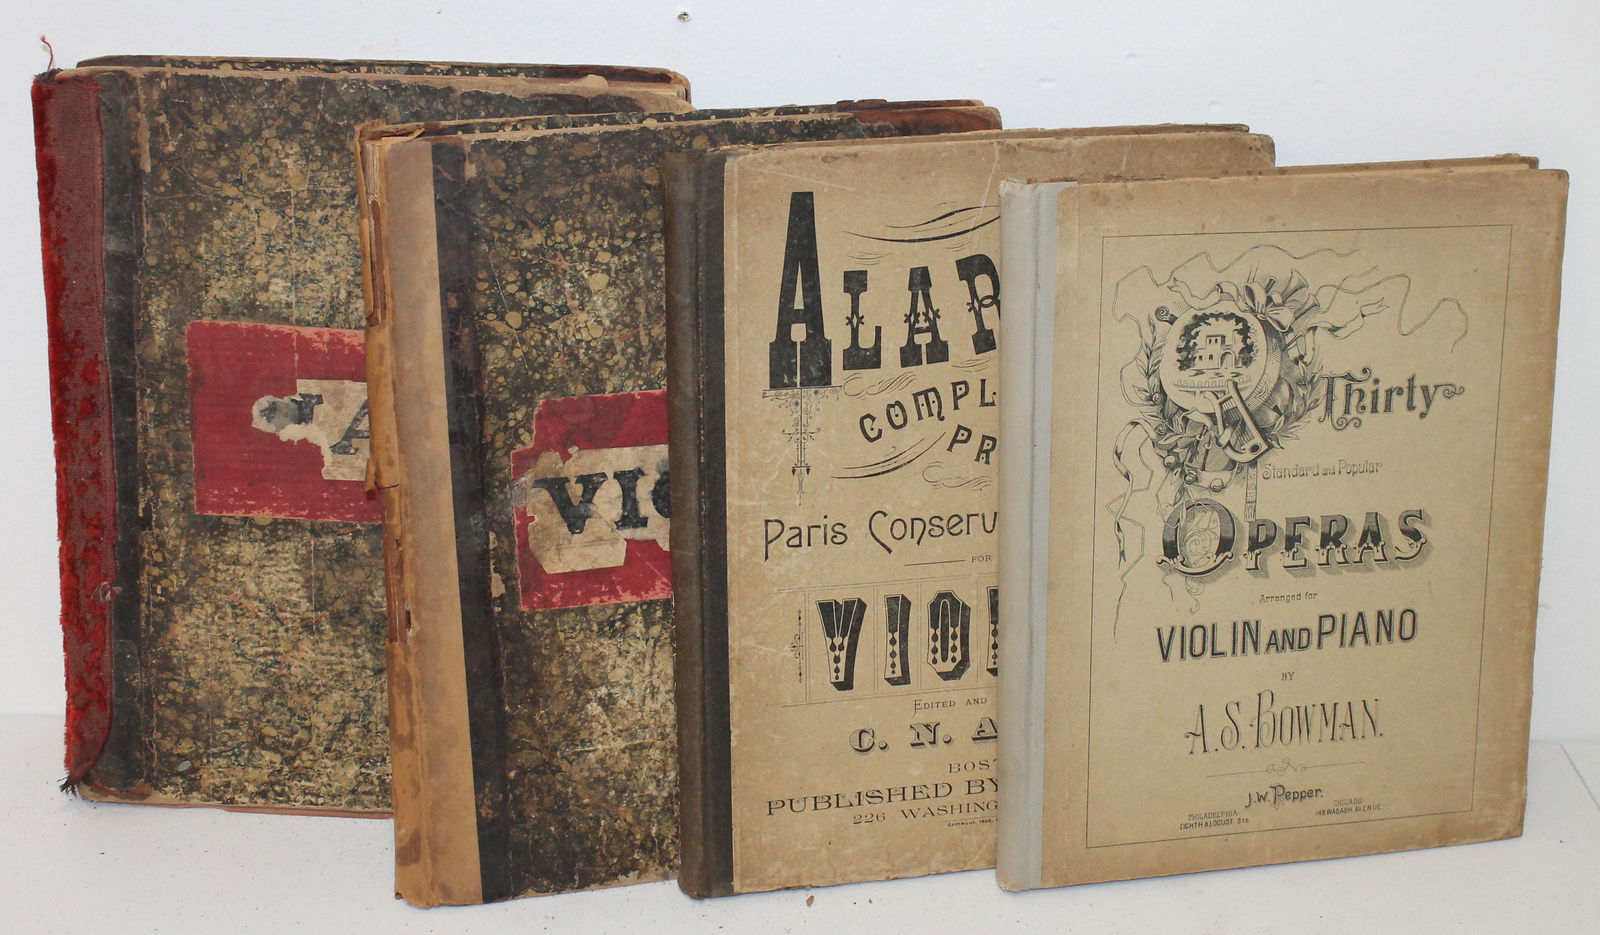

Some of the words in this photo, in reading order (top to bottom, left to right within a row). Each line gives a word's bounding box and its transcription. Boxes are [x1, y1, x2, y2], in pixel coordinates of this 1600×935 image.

[1318, 366, 1464, 431] Thirty
[946, 424, 997, 465] PR
[1262, 463, 1320, 480] Standard
[1321, 465, 1336, 477] and
[1337, 459, 1383, 477] Popular
[763, 514, 848, 562] Paris
[1156, 498, 1432, 578] OPERAS
[971, 555, 992, 563] FOR
[1259, 592, 1302, 604] Arranged
[1304, 591, 1319, 601] for
[1156, 618, 1262, 663] VIOLIN
[1264, 627, 1312, 654] AND
[1317, 608, 1419, 650] PIANO
[1281, 671, 1295, 681] BY
[965, 696, 988, 706] AND
[850, 727, 889, 755] C.
[910, 721, 953, 749] N.
[767, 781, 953, 816] PUBLISHED
[853, 812, 886, 825] 226
[901, 800, 998, 821] WASHING
[1179, 820, 1203, 831] EIGHTH
[1209, 817, 1234, 828] LOCUST
